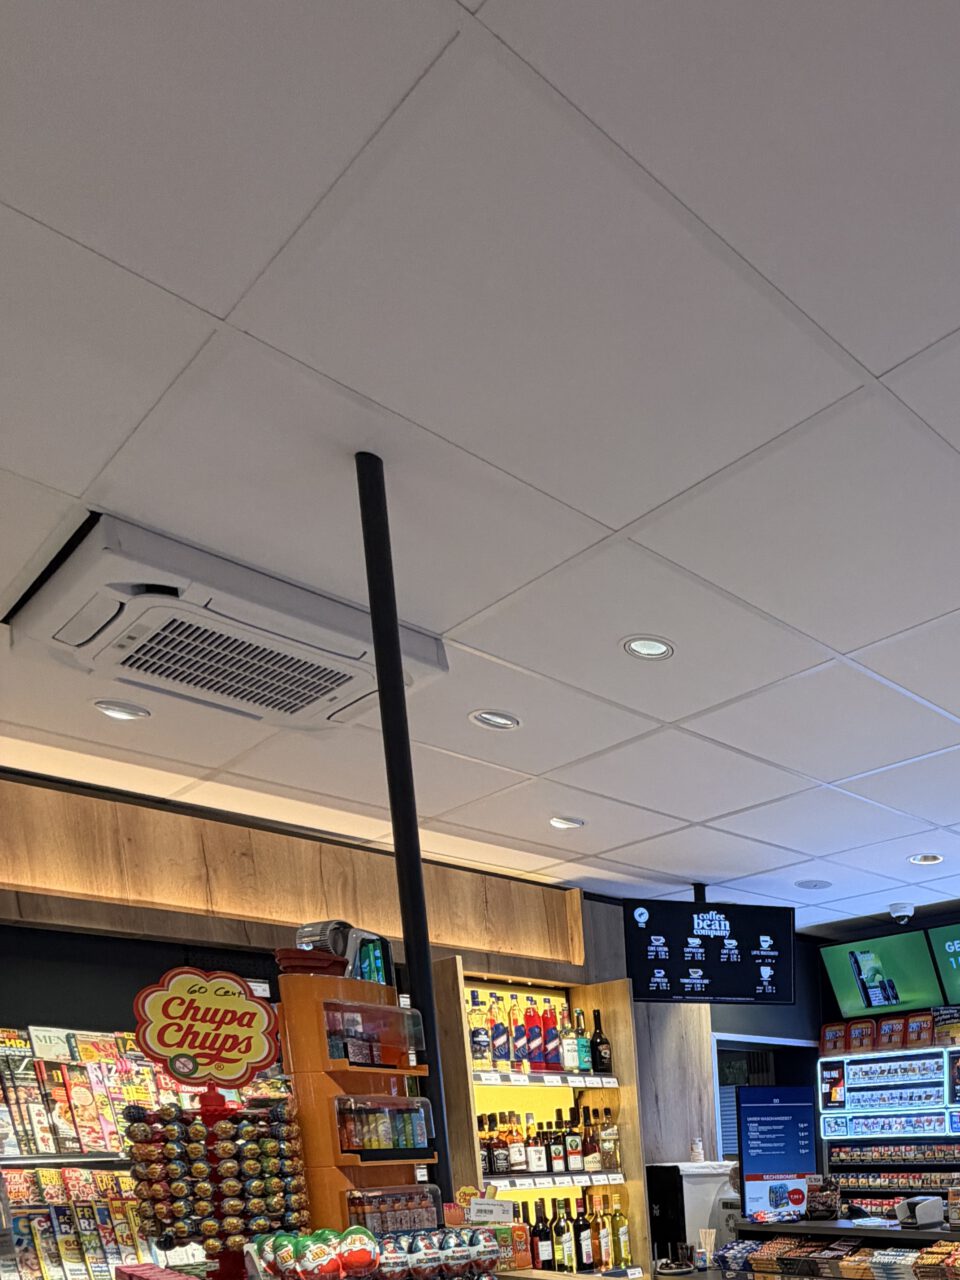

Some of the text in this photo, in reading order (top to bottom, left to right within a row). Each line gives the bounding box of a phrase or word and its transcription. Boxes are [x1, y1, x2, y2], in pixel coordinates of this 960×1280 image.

[699, 911, 725, 920] coffee
[693, 914, 730, 930] bean
[693, 929, 731, 938] company
[950, 958, 956, 969] 1
[187, 984, 208, 995] 60
[161, 996, 258, 1032] Chupa
[157, 1022, 254, 1066] Chups
